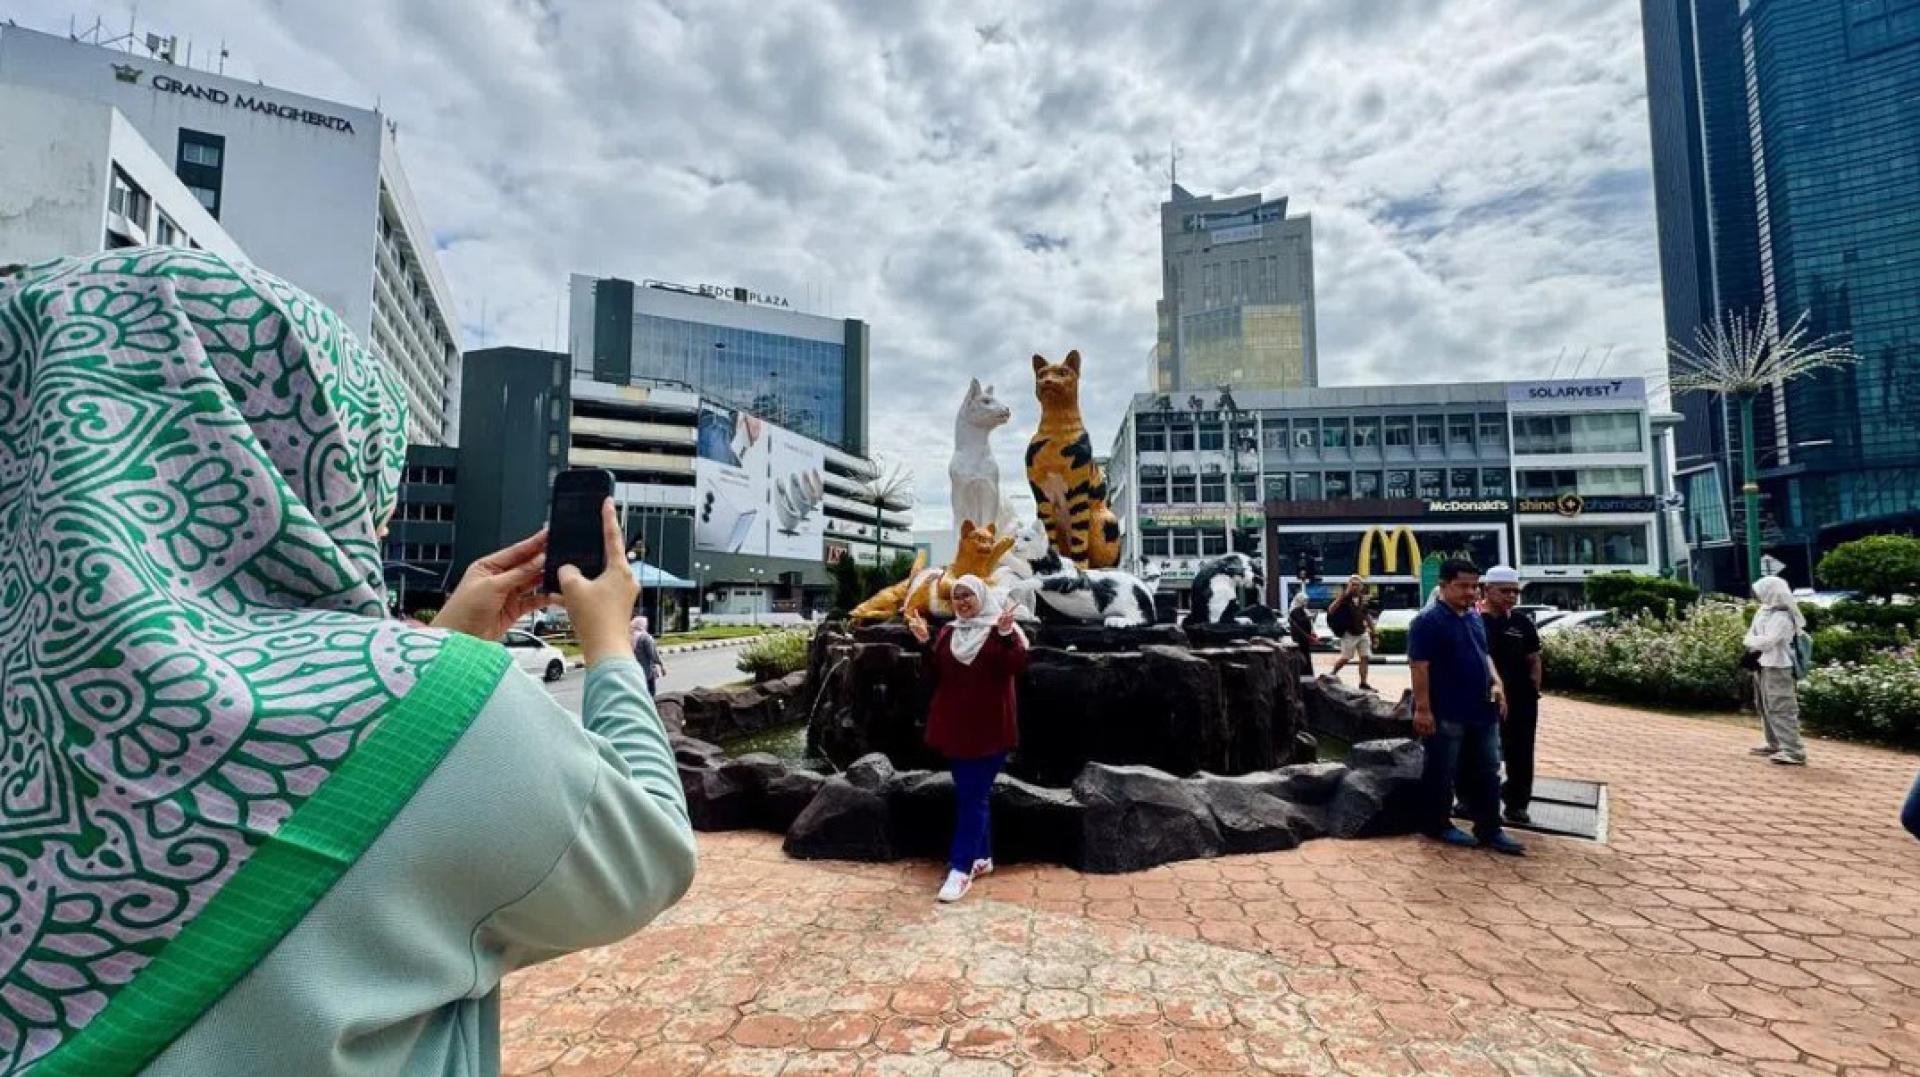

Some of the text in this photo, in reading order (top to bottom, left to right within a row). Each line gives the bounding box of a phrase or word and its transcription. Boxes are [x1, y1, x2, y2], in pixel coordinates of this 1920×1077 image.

[152, 75, 356, 134] GRAND MARGHERITA
[699, 283, 789, 307] SEDC PLAZA
[1528, 385, 1610, 399] SOLARVEST
[1428, 500, 1510, 512] McDonald's
[1519, 500, 1556, 511] shine
